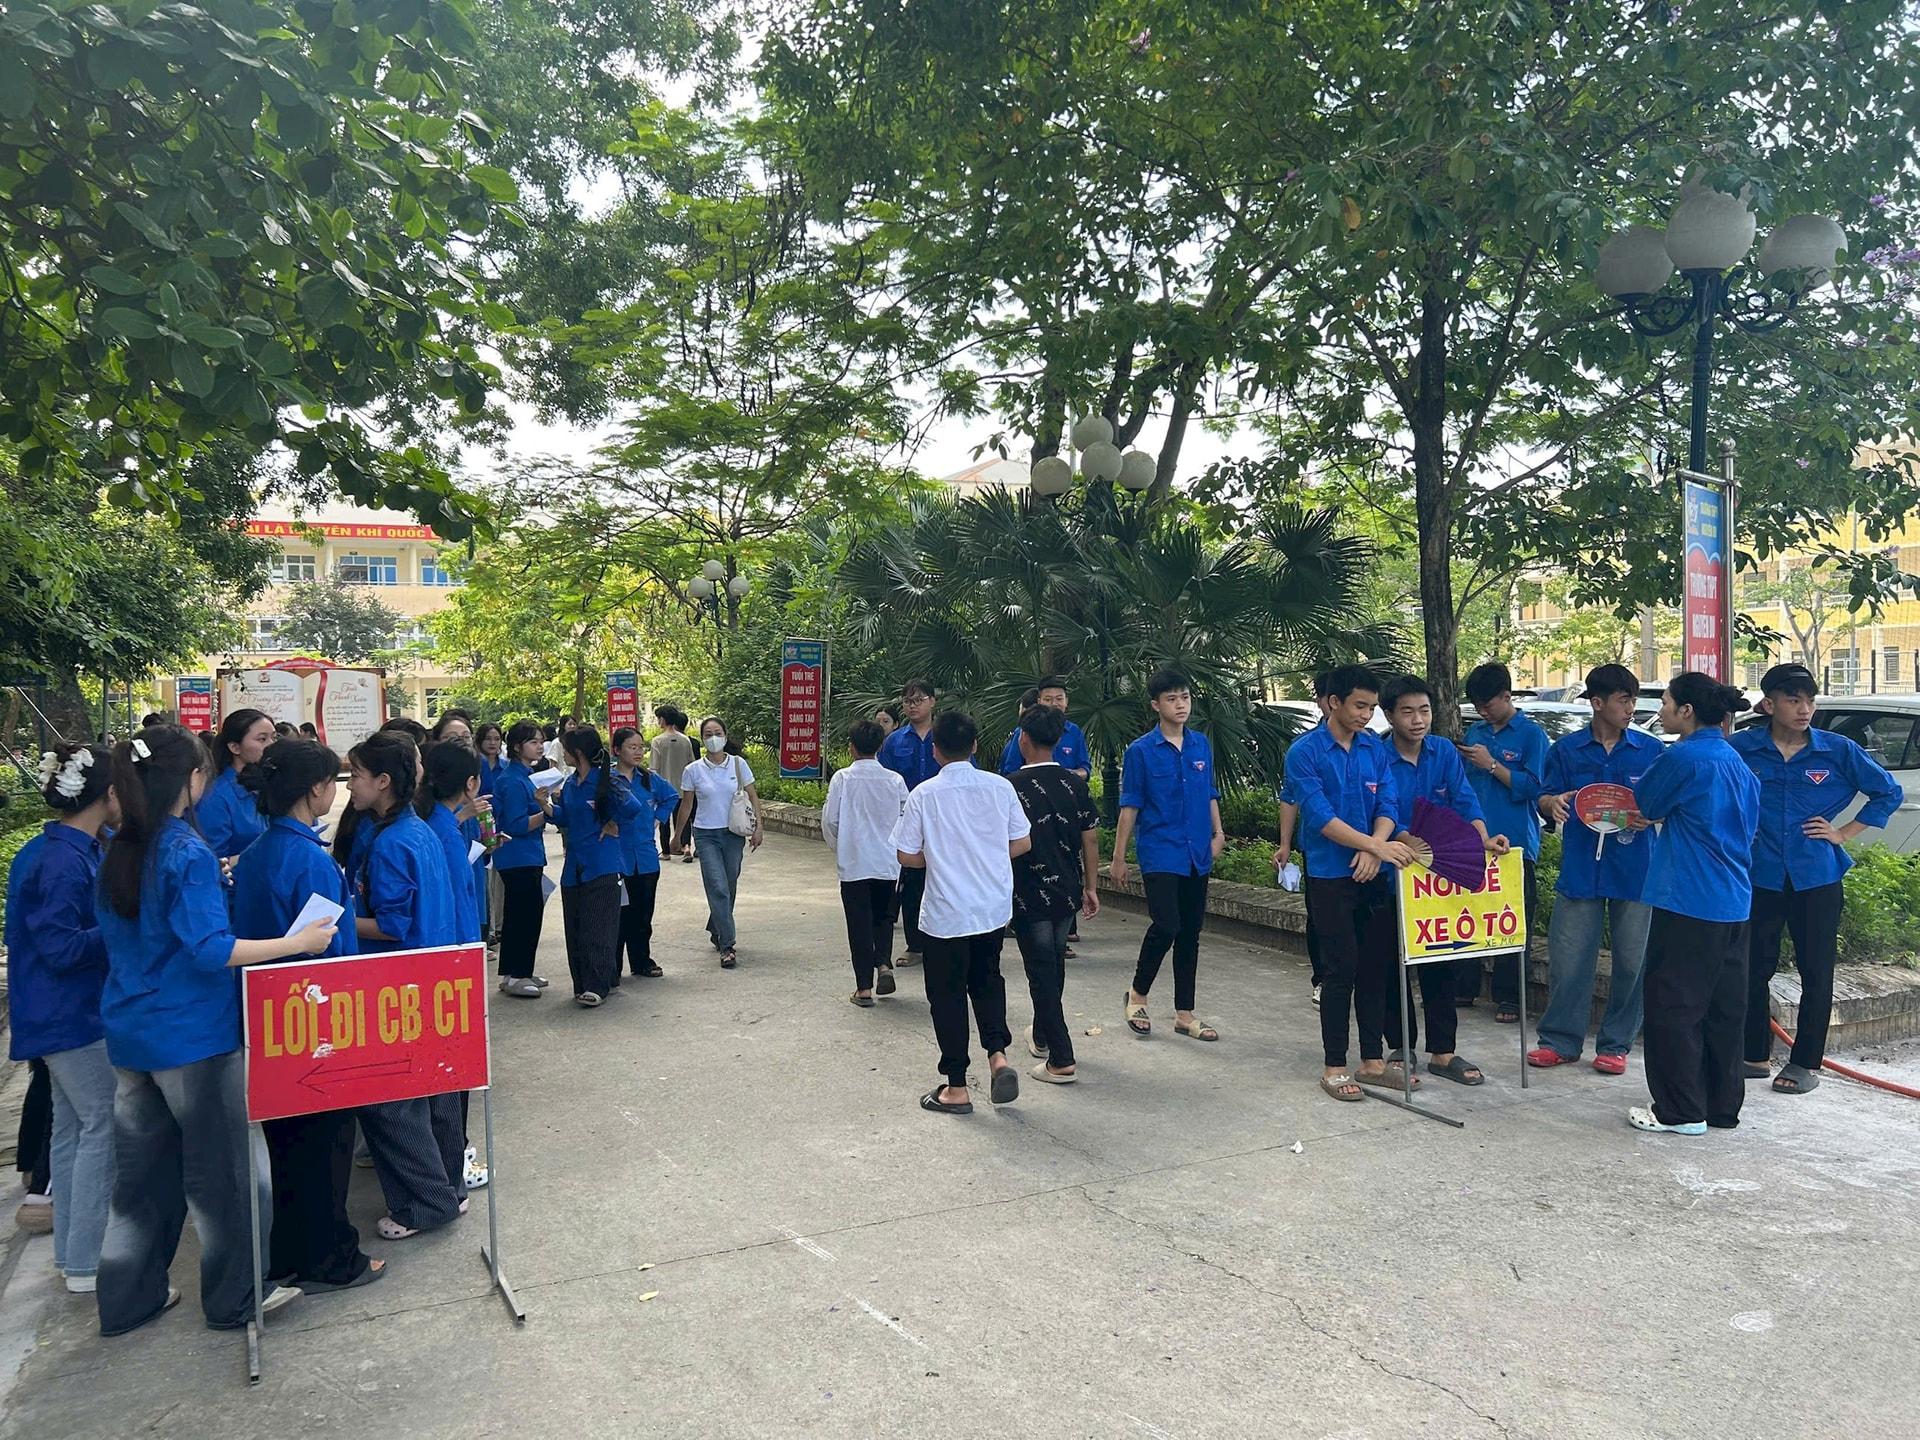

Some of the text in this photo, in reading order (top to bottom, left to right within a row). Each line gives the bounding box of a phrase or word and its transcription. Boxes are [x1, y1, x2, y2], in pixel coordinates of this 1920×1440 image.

[356, 526, 382, 537] KHÍ
[386, 526, 426, 538] QUỐC
[804, 669, 815, 681] TRẺ
[789, 683, 816, 694] ĐOÀN KẾT
[788, 699, 816, 709] XUNG KÍCH
[788, 713, 815, 725] SÁNG TẠO
[786, 738, 817, 751] PHÁT TRIỂN
[1415, 903, 1517, 945] XE Ô TÔ
[263, 978, 473, 1058] LỐI ĐI CB CT
